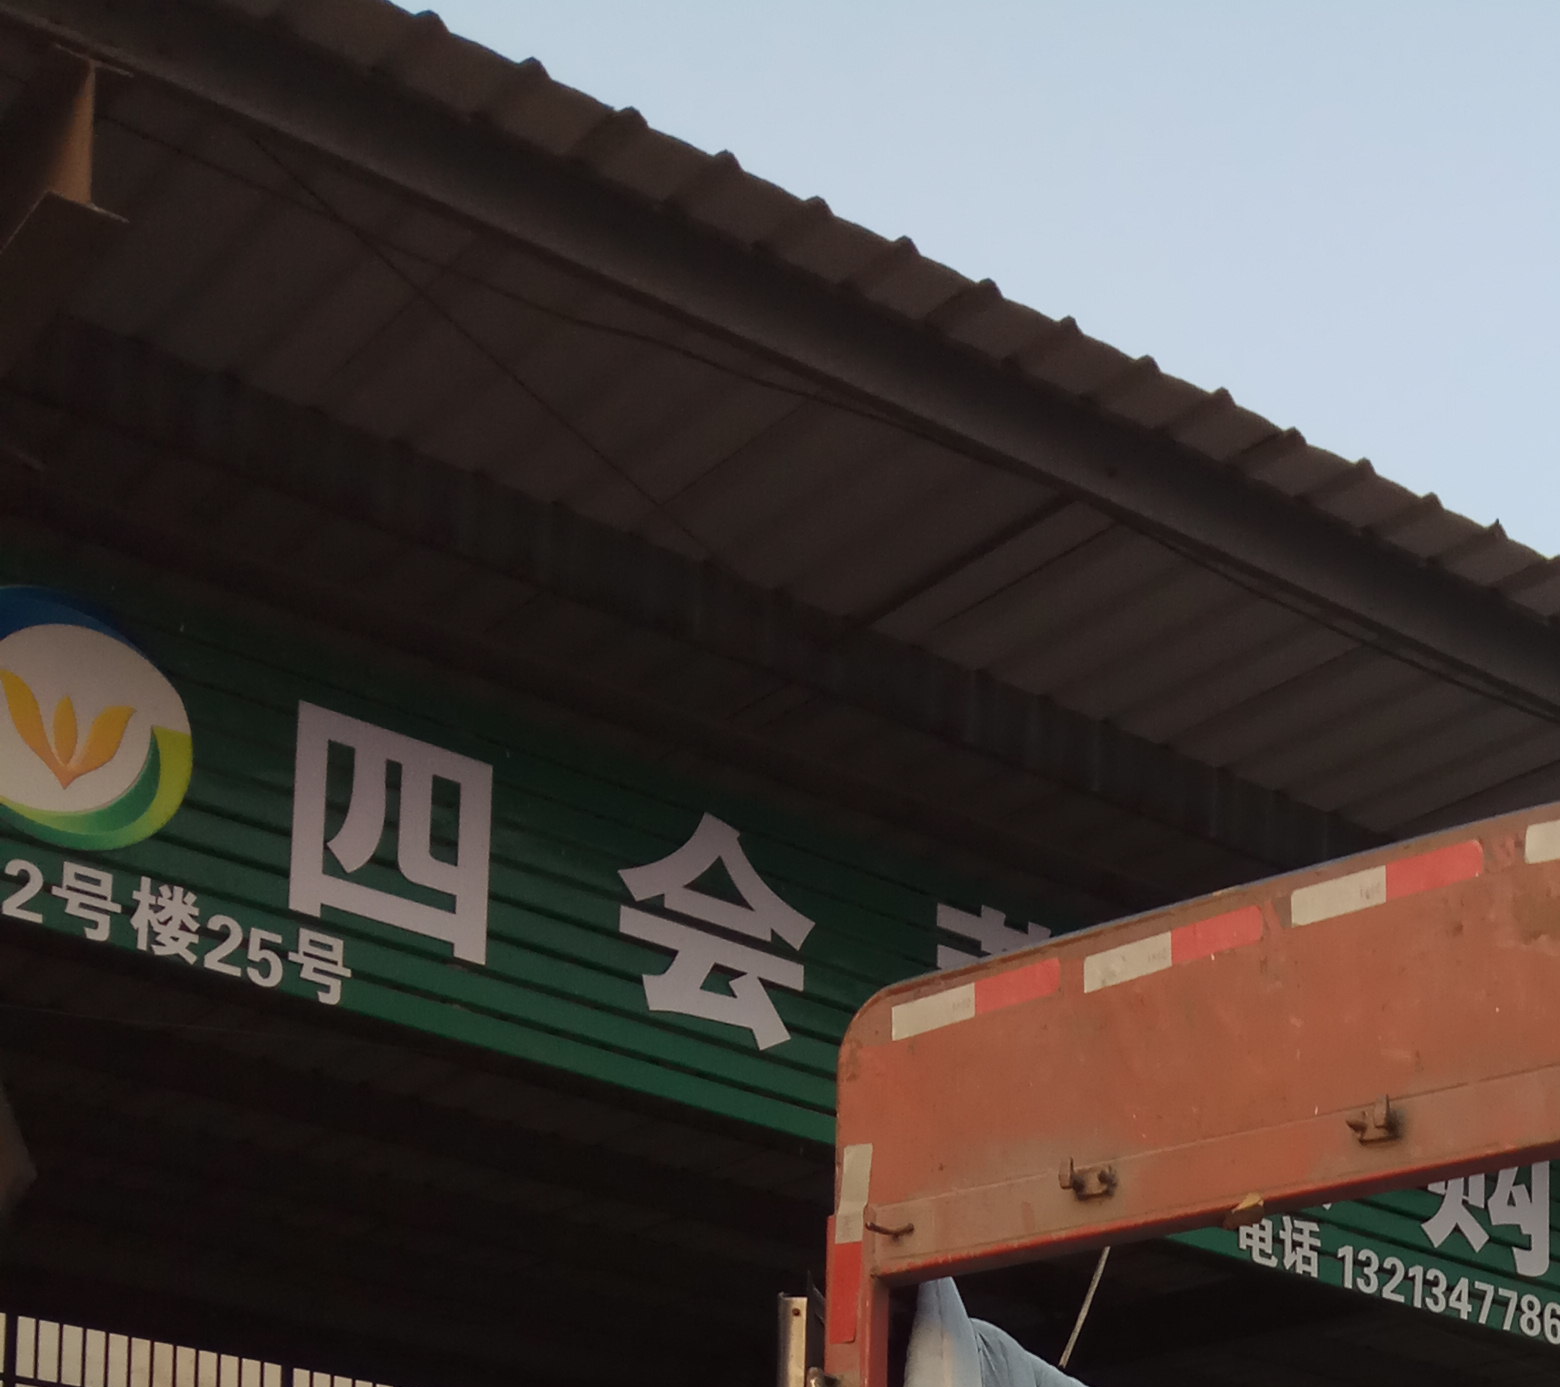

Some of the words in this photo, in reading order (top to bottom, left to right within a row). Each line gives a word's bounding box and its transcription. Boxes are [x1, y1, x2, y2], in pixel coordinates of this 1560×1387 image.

[2, 858, 352, 1007] 2号楼25号
[1238, 1216, 1322, 1278] 电话
